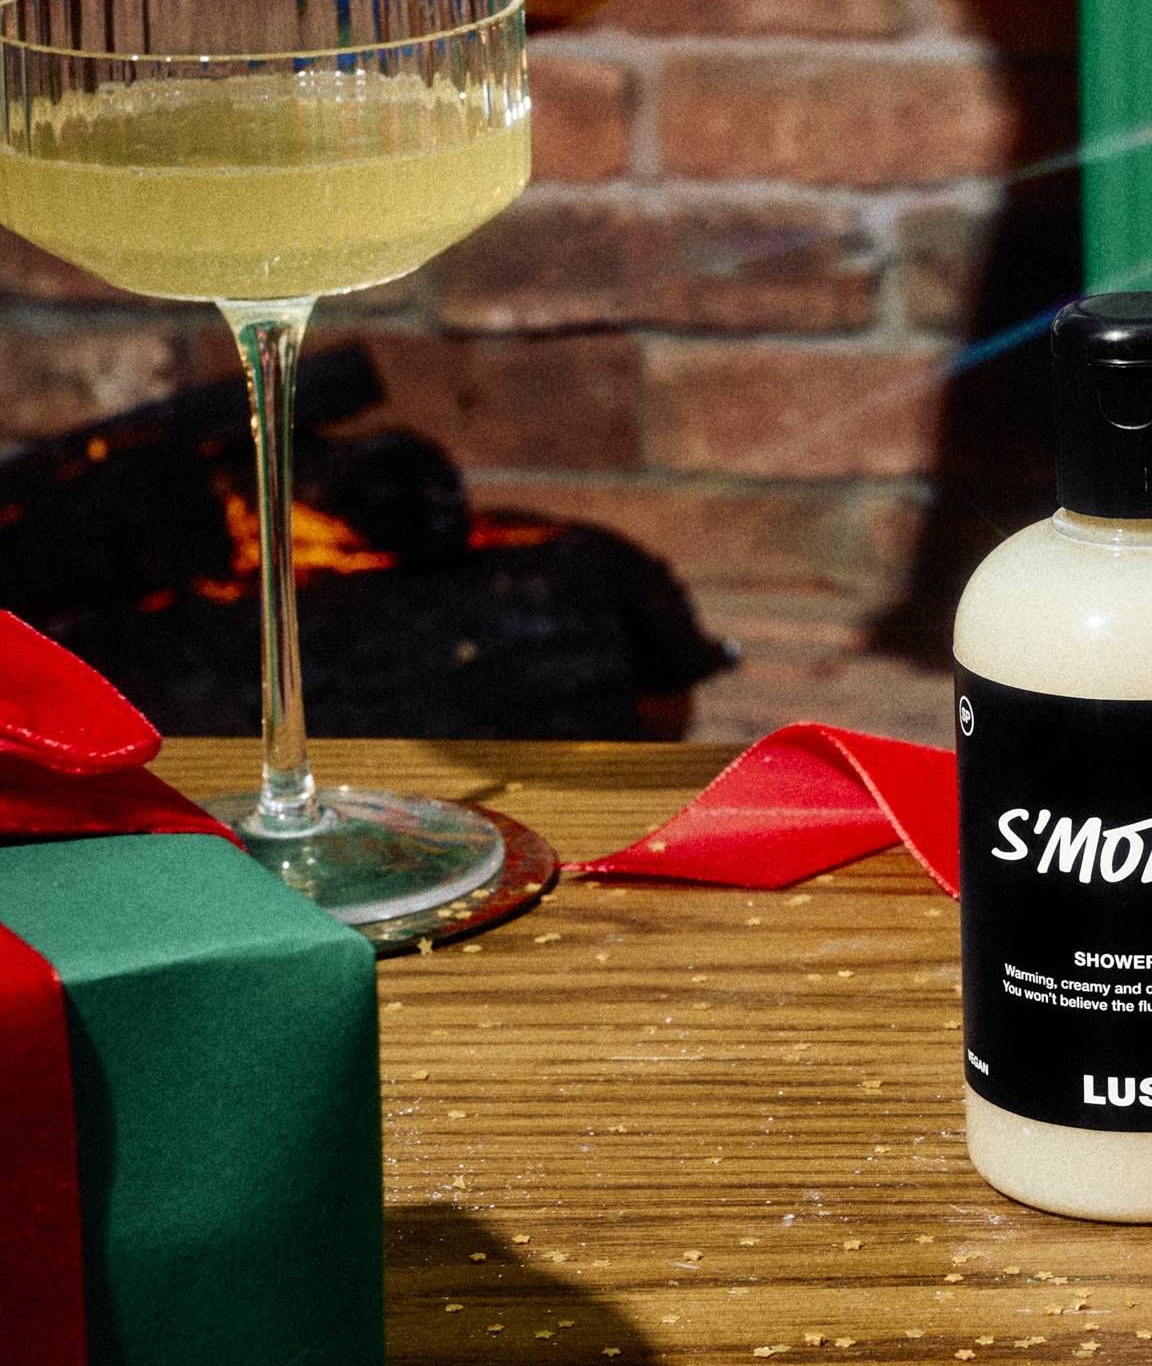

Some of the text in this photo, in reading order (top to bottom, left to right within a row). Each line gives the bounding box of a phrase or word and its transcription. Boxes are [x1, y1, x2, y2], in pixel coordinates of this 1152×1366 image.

[1003, 979, 1022, 997] You
[1024, 988, 1057, 1005] won't
[1060, 994, 1108, 1011] believe
[1111, 999, 1135, 1012] the
[1004, 962, 1058, 990] Warming,
[1060, 979, 1111, 996] creamy
[1114, 982, 1142, 995] and
